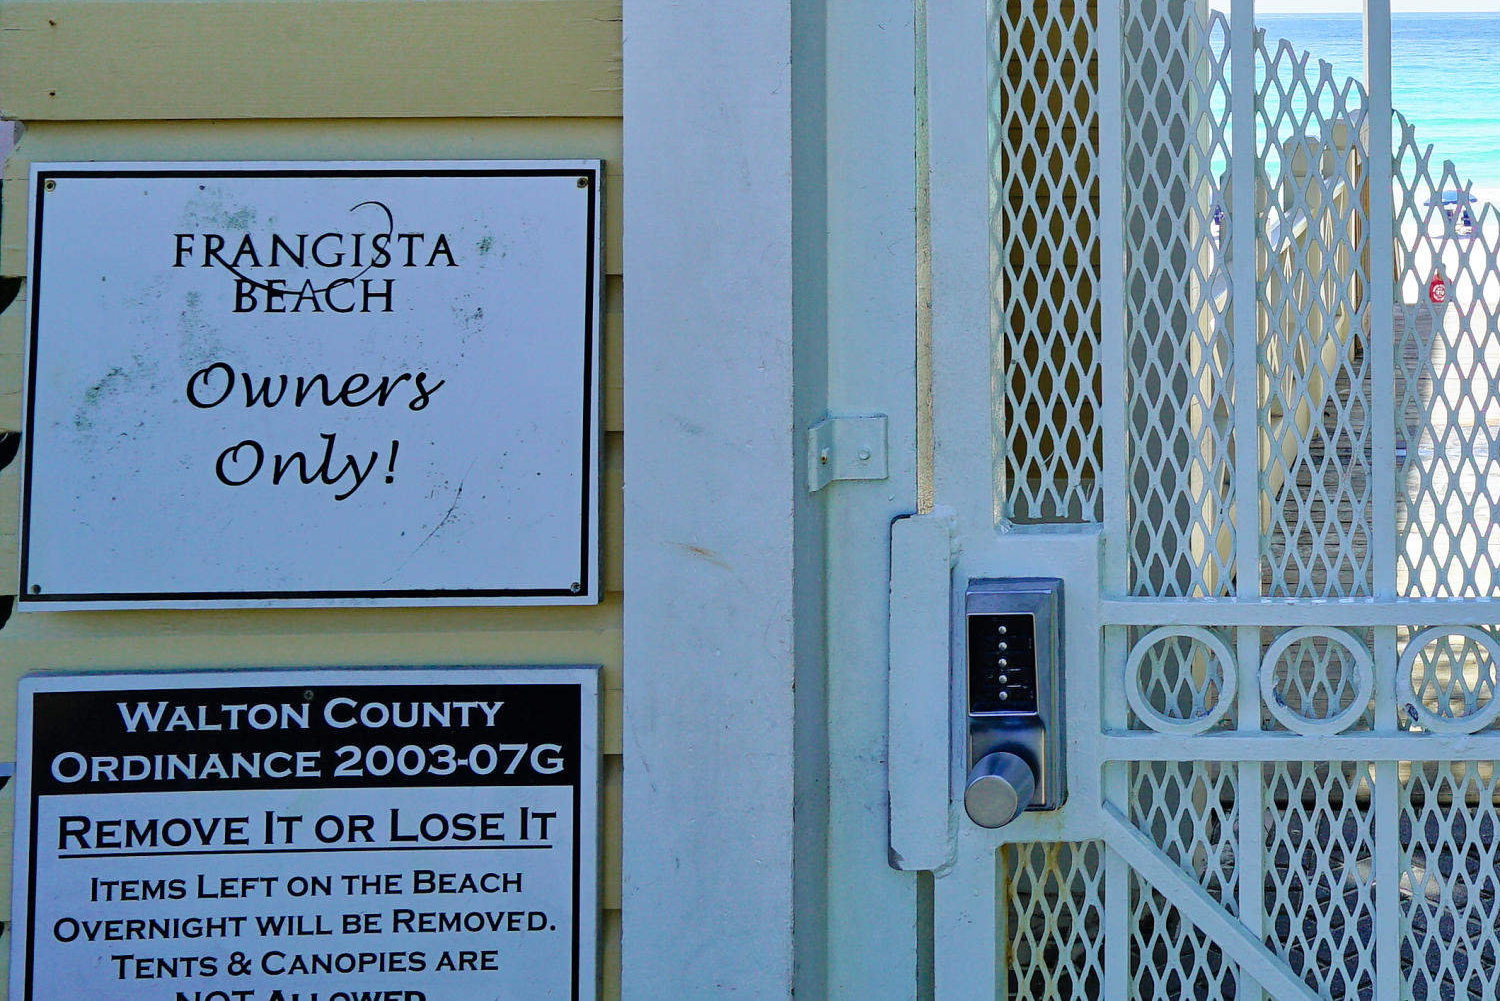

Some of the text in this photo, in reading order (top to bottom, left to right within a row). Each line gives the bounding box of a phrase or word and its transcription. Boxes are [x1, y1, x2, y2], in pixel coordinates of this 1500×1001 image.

[172, 232, 459, 268] FRANGISTA
[232, 278, 396, 313] BEACH
[186, 361, 446, 411] Owners
[215, 432, 400, 501] Only!
[117, 698, 504, 733] WALTON COUNTY
[51, 743, 565, 783] ORDINANCE 2003-07G
[58, 806, 557, 849] REMOVE IT OR LOSE IT
[91, 870, 523, 902] ITEMS LEFT ON THE BEACH
[53, 909, 556, 943] OVERNIGHT WILL BE REMOVED.
[111, 950, 499, 980] TENTS & CANOPIES ARE
